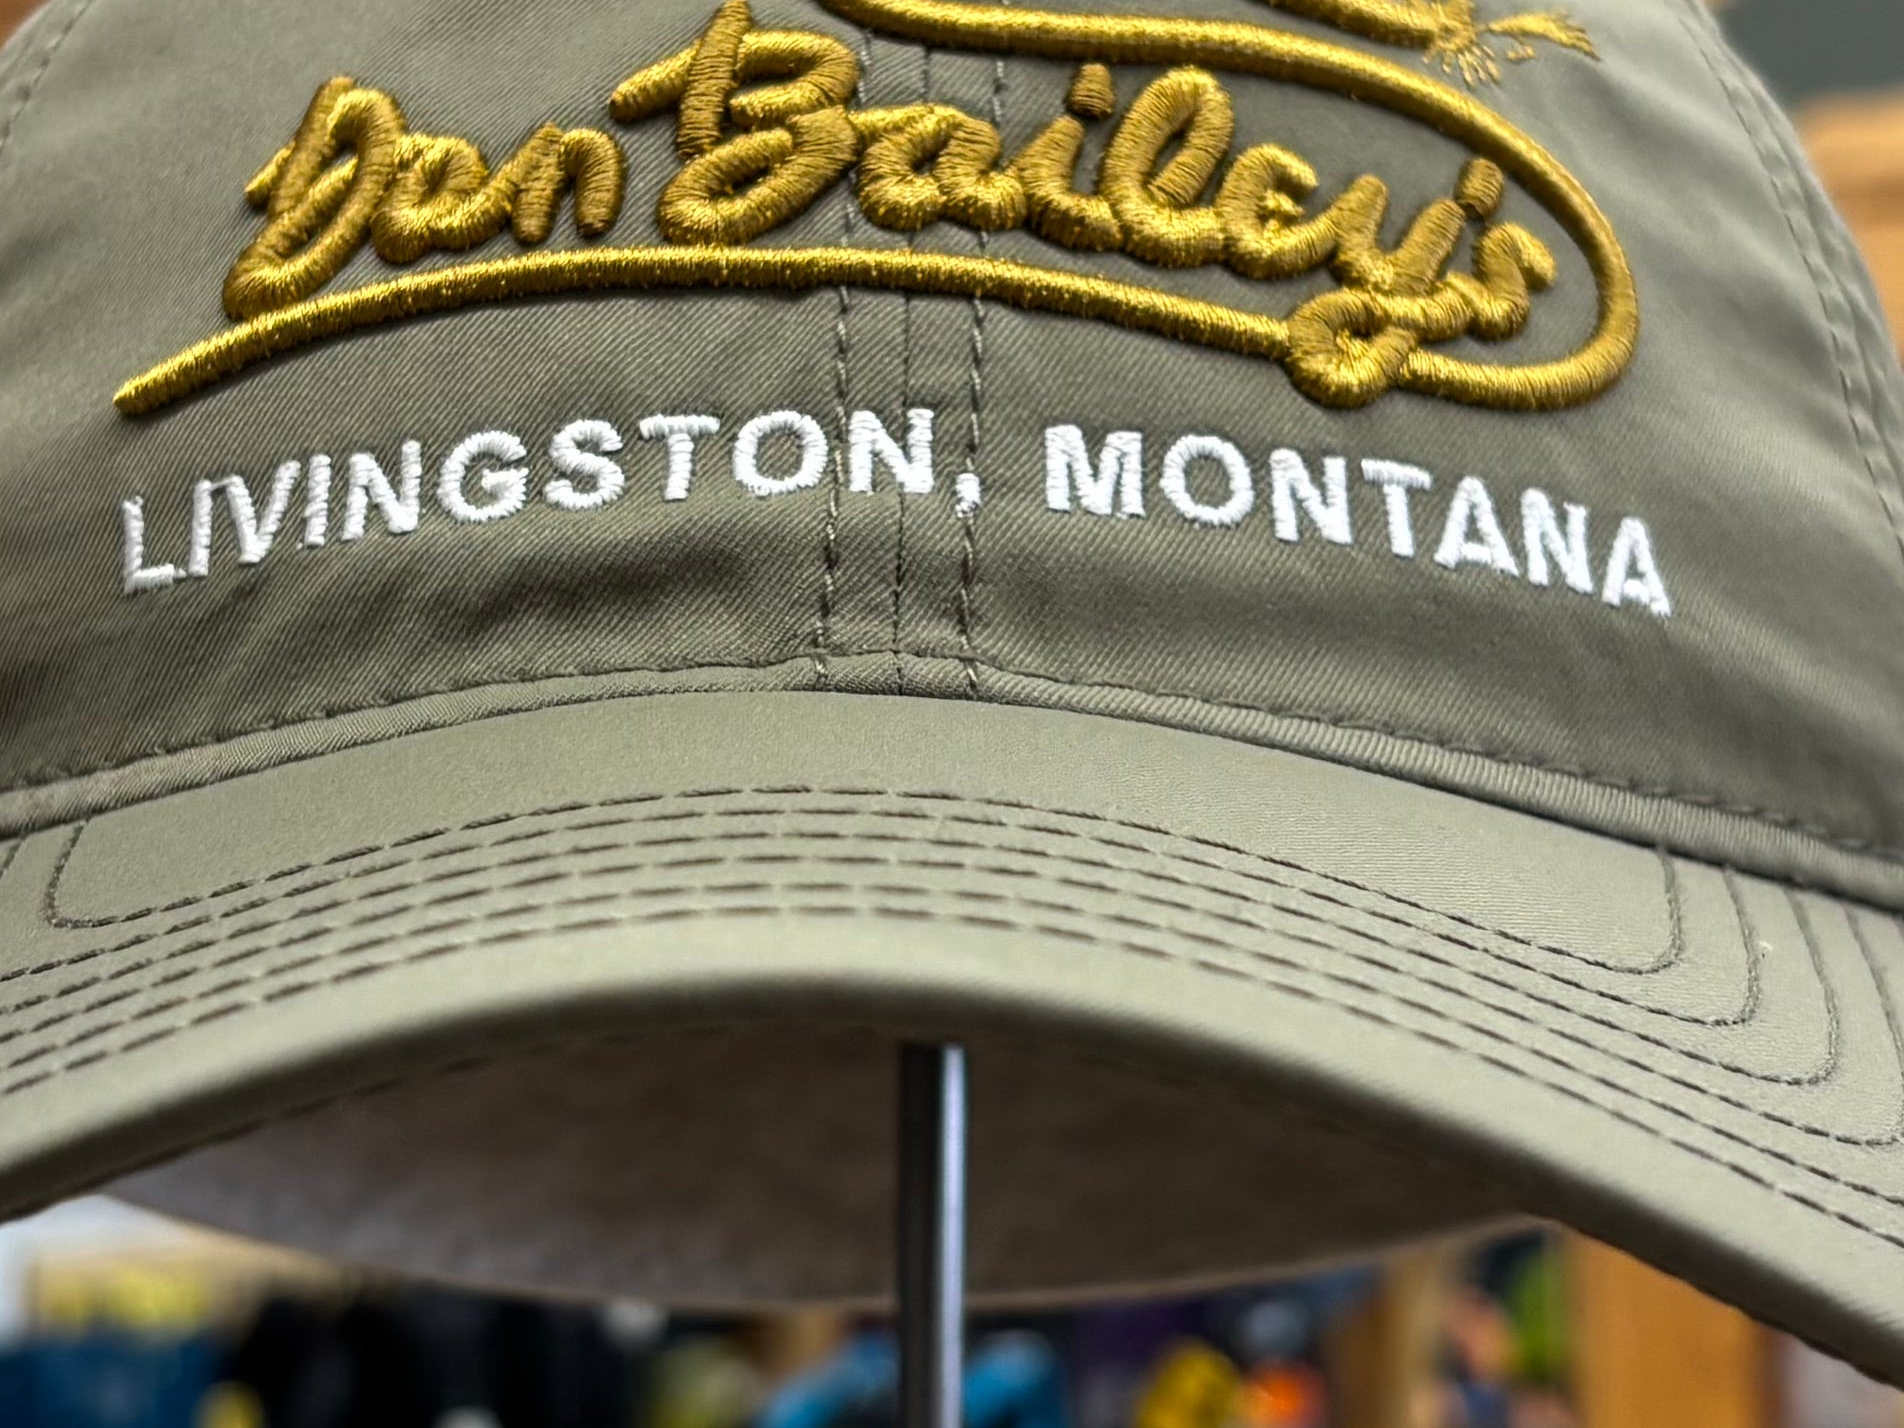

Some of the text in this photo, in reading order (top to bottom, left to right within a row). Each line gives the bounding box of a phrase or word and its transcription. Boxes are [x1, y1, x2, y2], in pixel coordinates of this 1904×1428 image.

[222, 76, 626, 320] Dan
[120, 406, 1673, 620] LIVINGSTON, MONTANA
